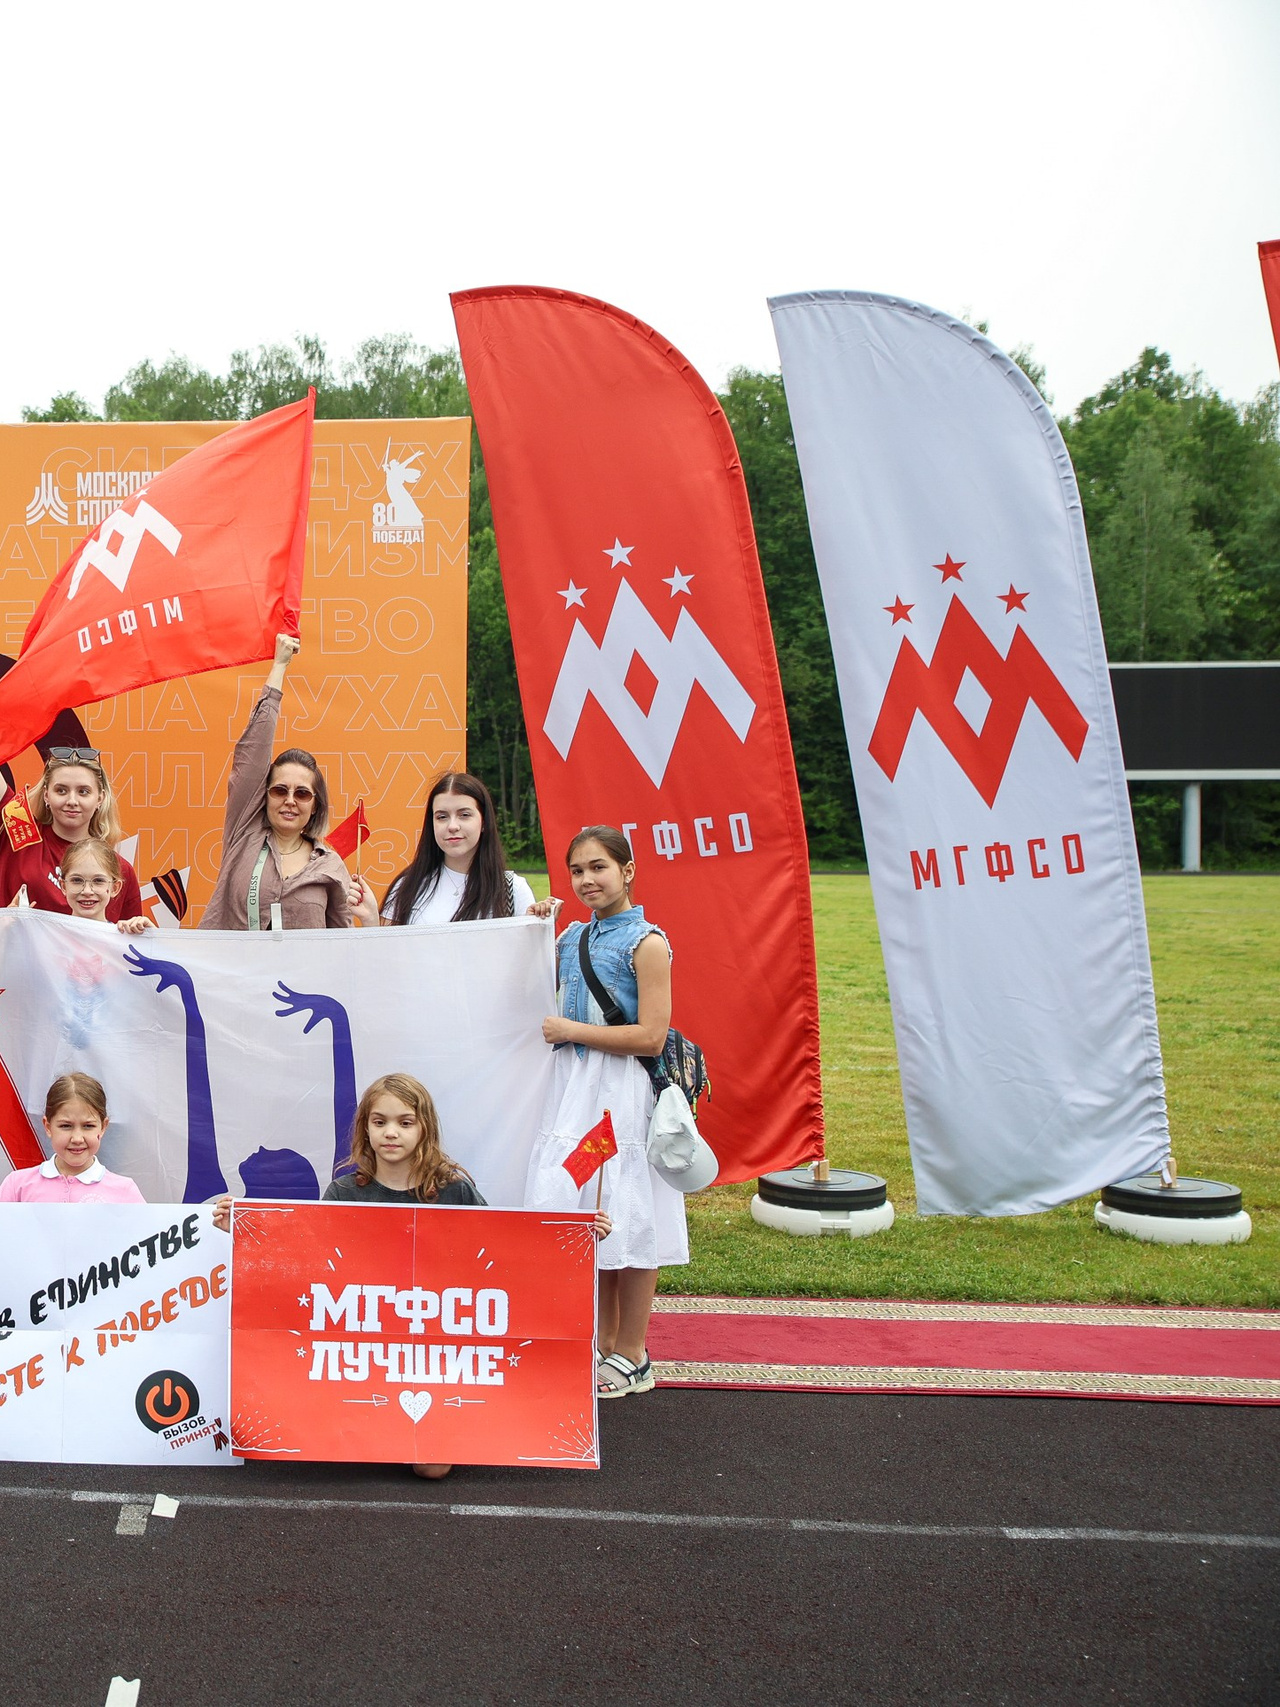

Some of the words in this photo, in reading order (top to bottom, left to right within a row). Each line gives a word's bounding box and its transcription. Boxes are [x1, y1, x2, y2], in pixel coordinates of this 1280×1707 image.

[310, 441, 467, 511] ДУХ
[372, 529, 425, 545] ПОБЕДА!
[581, 812, 754, 862] ГФСО
[909, 833, 1086, 891] МГФСО
[249, 875, 259, 906] GUESS
[29, 1212, 201, 1326] ЕДИНСТВЕ
[60, 1336, 85, 1373] К
[93, 1263, 228, 1356] ПОБЕДЕ
[308, 1282, 510, 1337] МГФСО
[307, 1340, 505, 1386] ЛУЧШИЕ
[163, 1415, 207, 1441] ВЫЗОВ
[169, 1422, 217, 1450] ПРИНЯТ
